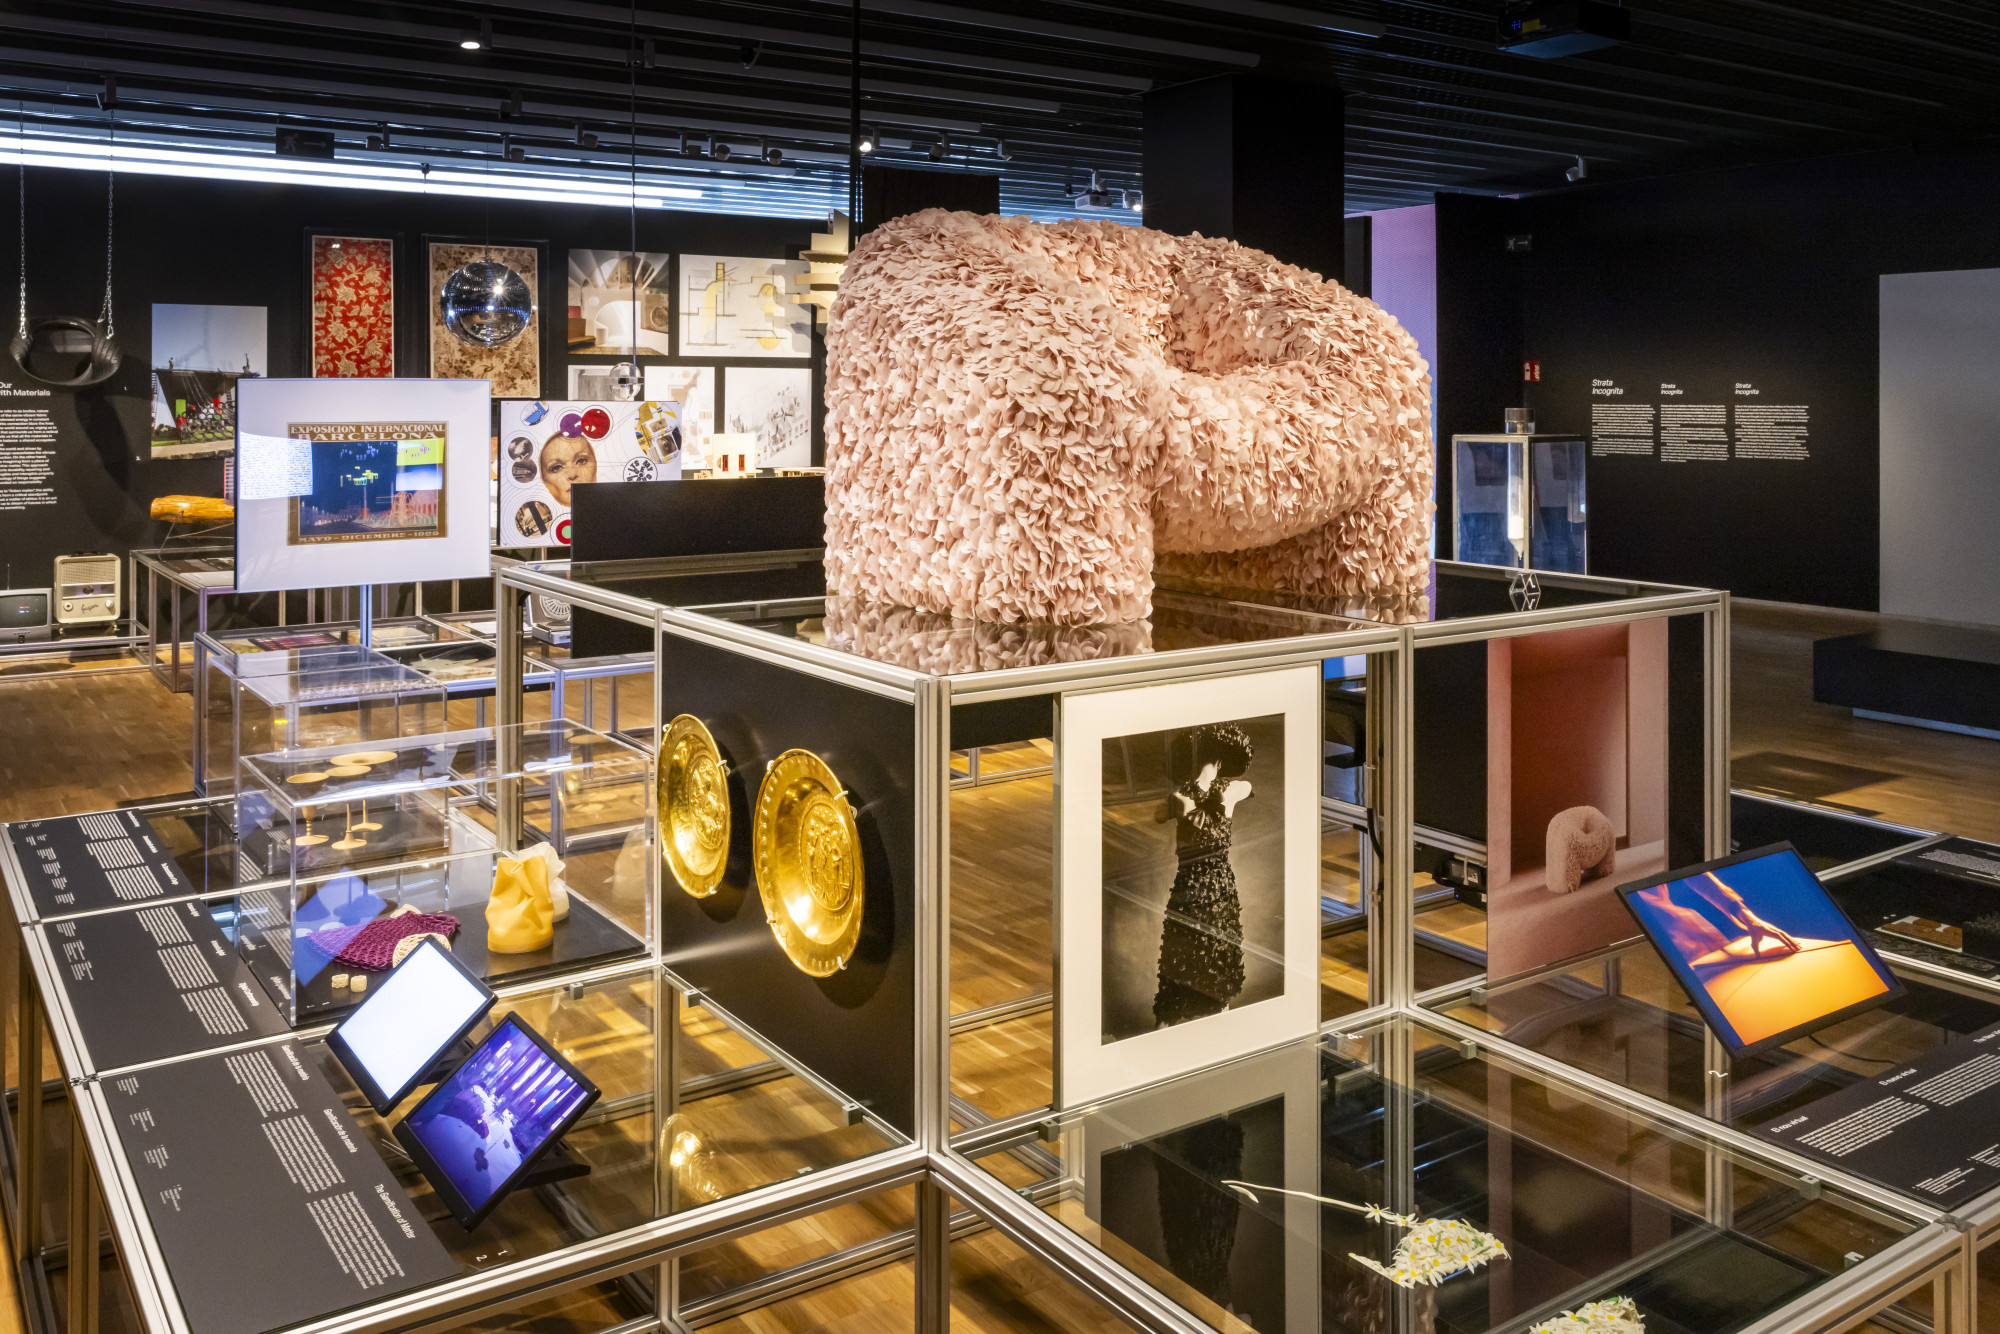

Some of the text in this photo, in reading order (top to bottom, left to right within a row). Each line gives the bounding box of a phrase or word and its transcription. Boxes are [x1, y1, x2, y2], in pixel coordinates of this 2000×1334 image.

[1592, 379, 1613, 387] Strata
[1592, 387, 1624, 397] Incognita
[290, 424, 446, 434] EXPOSICION INTERNACIONAL
[298, 432, 438, 441] BARCELONA
[298, 535, 332, 543] MAYO
[341, 531, 406, 541] DICIEMBRE
[374, 1183, 385, 1194] The
[379, 1192, 402, 1219] Gamification
[399, 1222, 416, 1238] Matter
